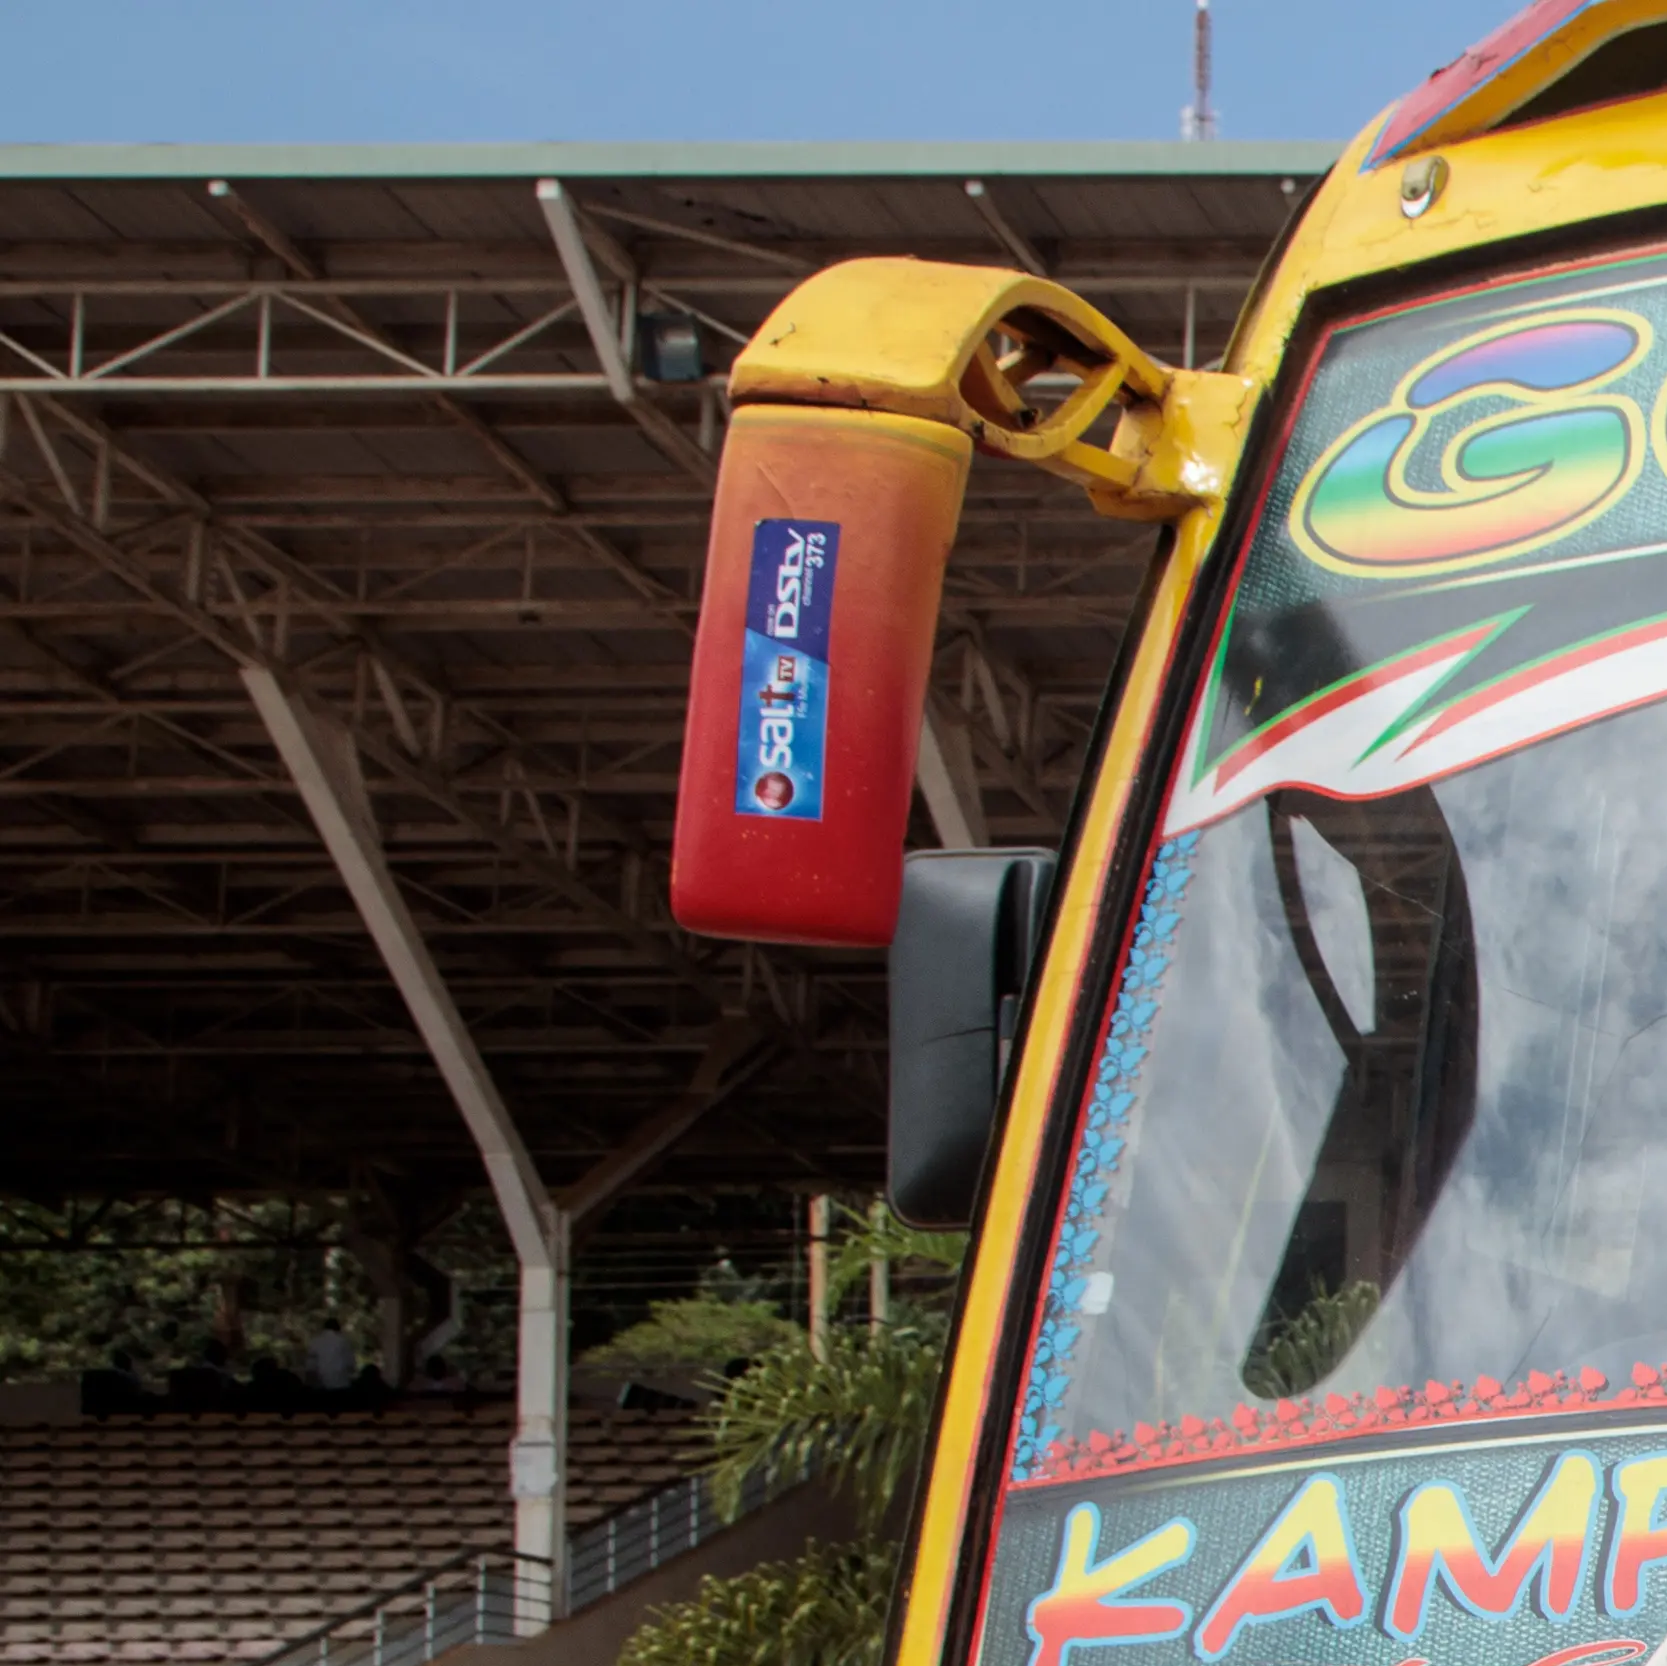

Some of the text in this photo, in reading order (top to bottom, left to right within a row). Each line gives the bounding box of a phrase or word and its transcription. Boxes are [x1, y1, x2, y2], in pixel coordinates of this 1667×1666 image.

[806, 532, 827, 569] 373
[759, 658, 795, 768] salt TV
